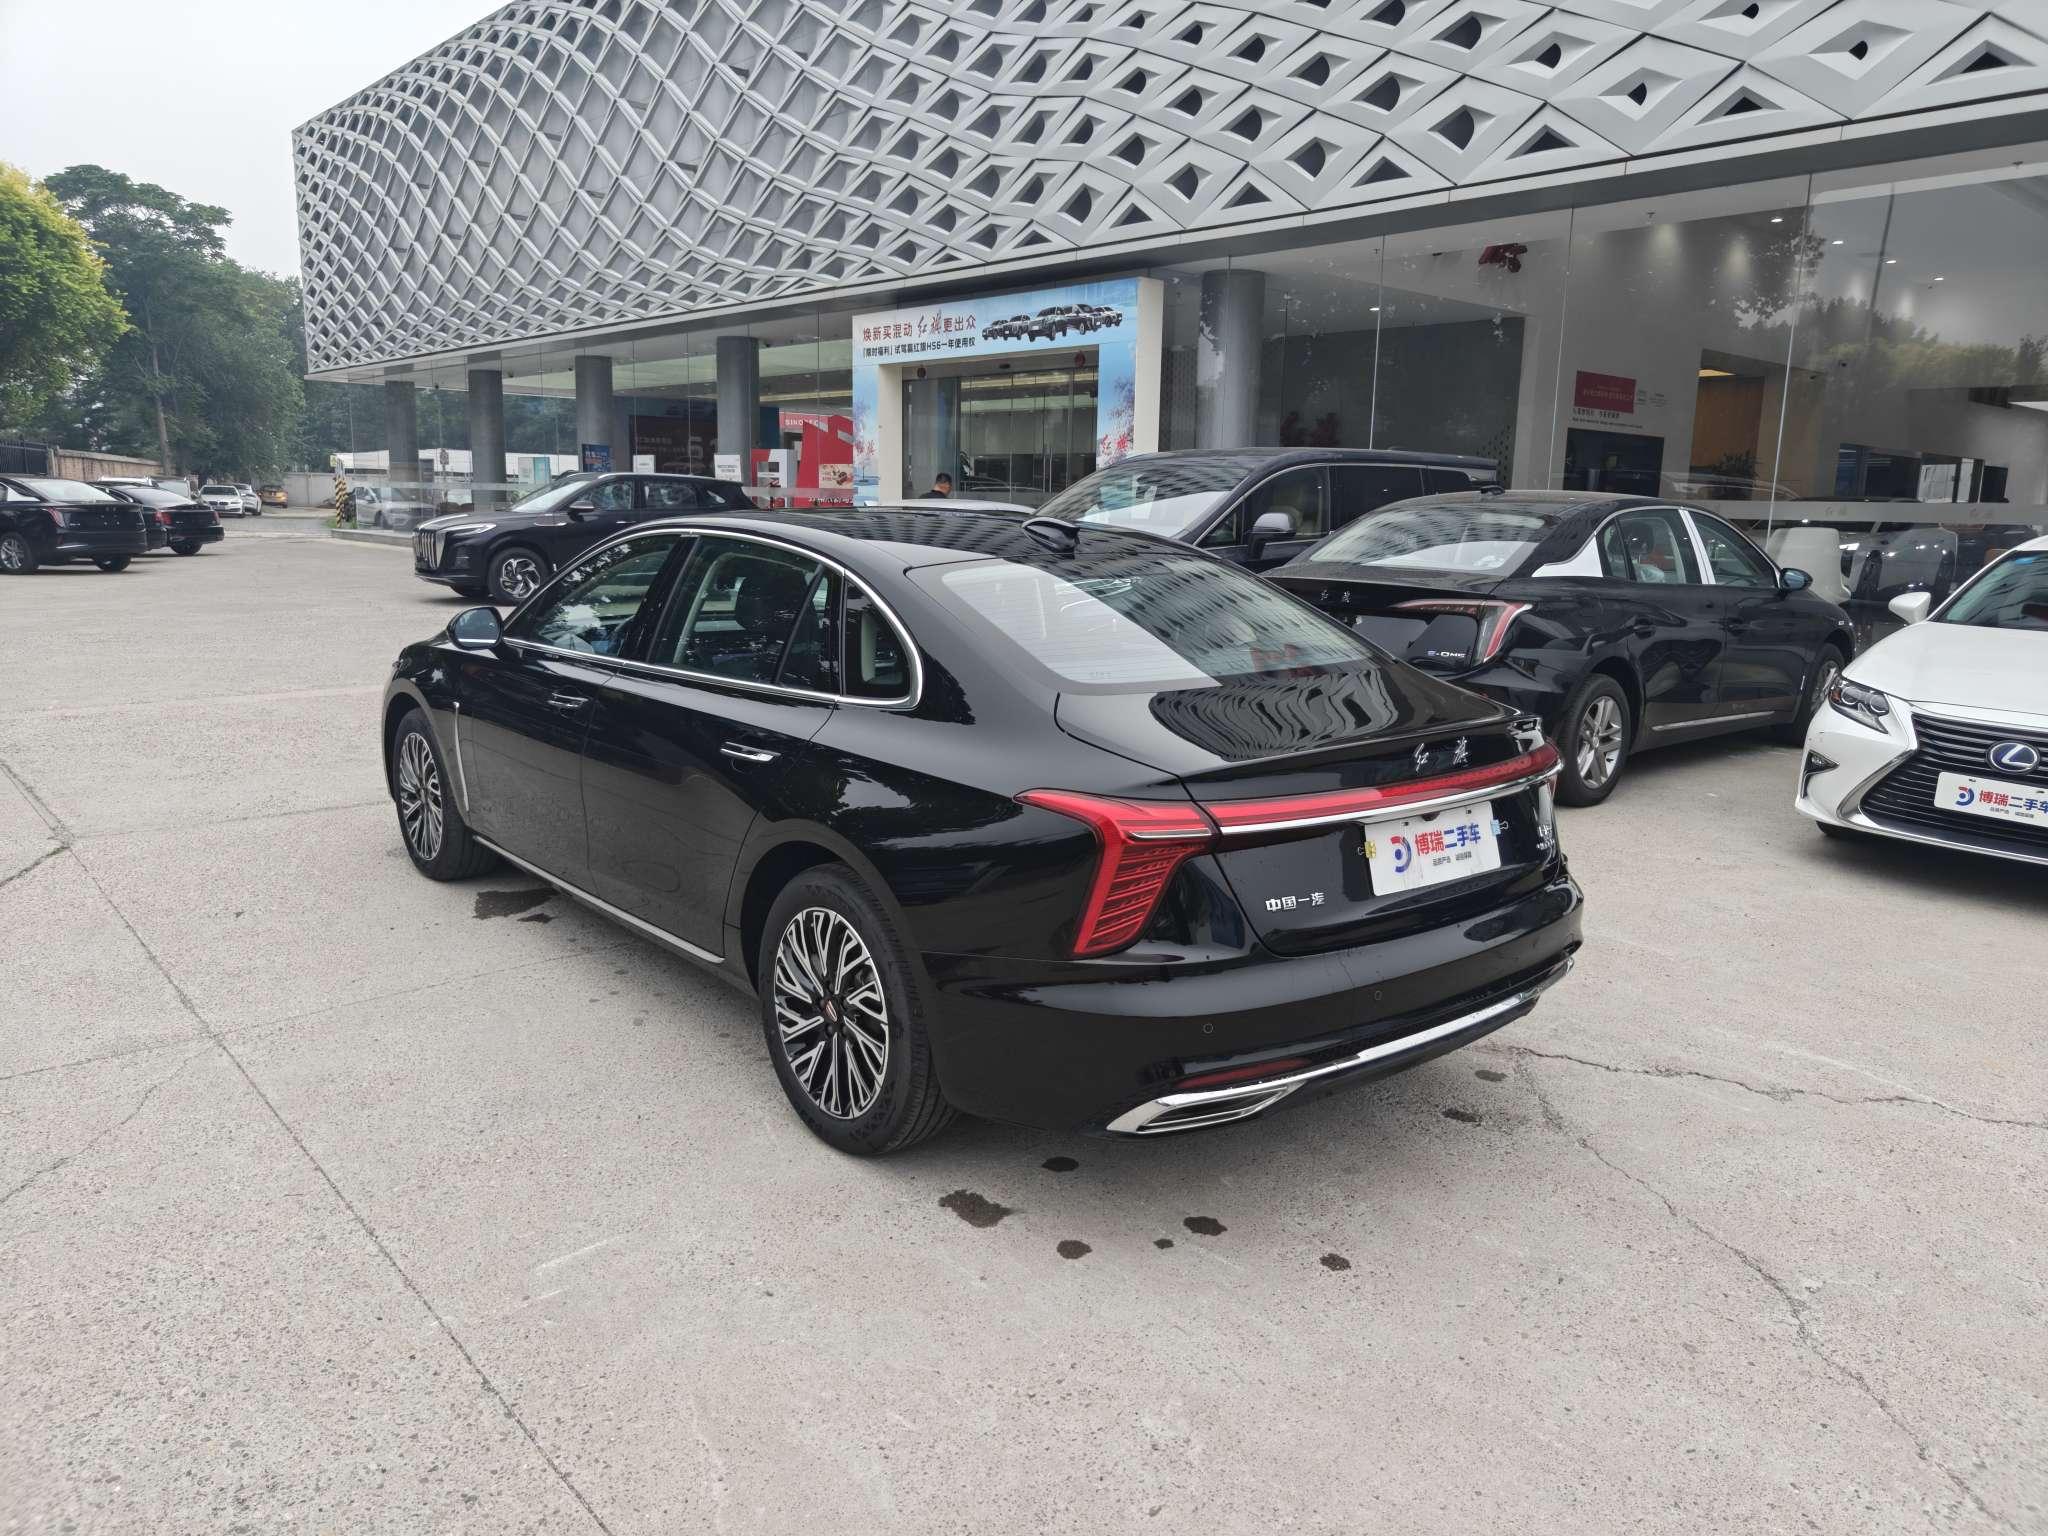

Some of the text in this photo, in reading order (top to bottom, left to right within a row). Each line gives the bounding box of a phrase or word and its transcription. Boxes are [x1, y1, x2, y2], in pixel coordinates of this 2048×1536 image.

[1414, 822, 1481, 856] 博瑞二手车
[1265, 892, 1325, 912] 中国一汽
